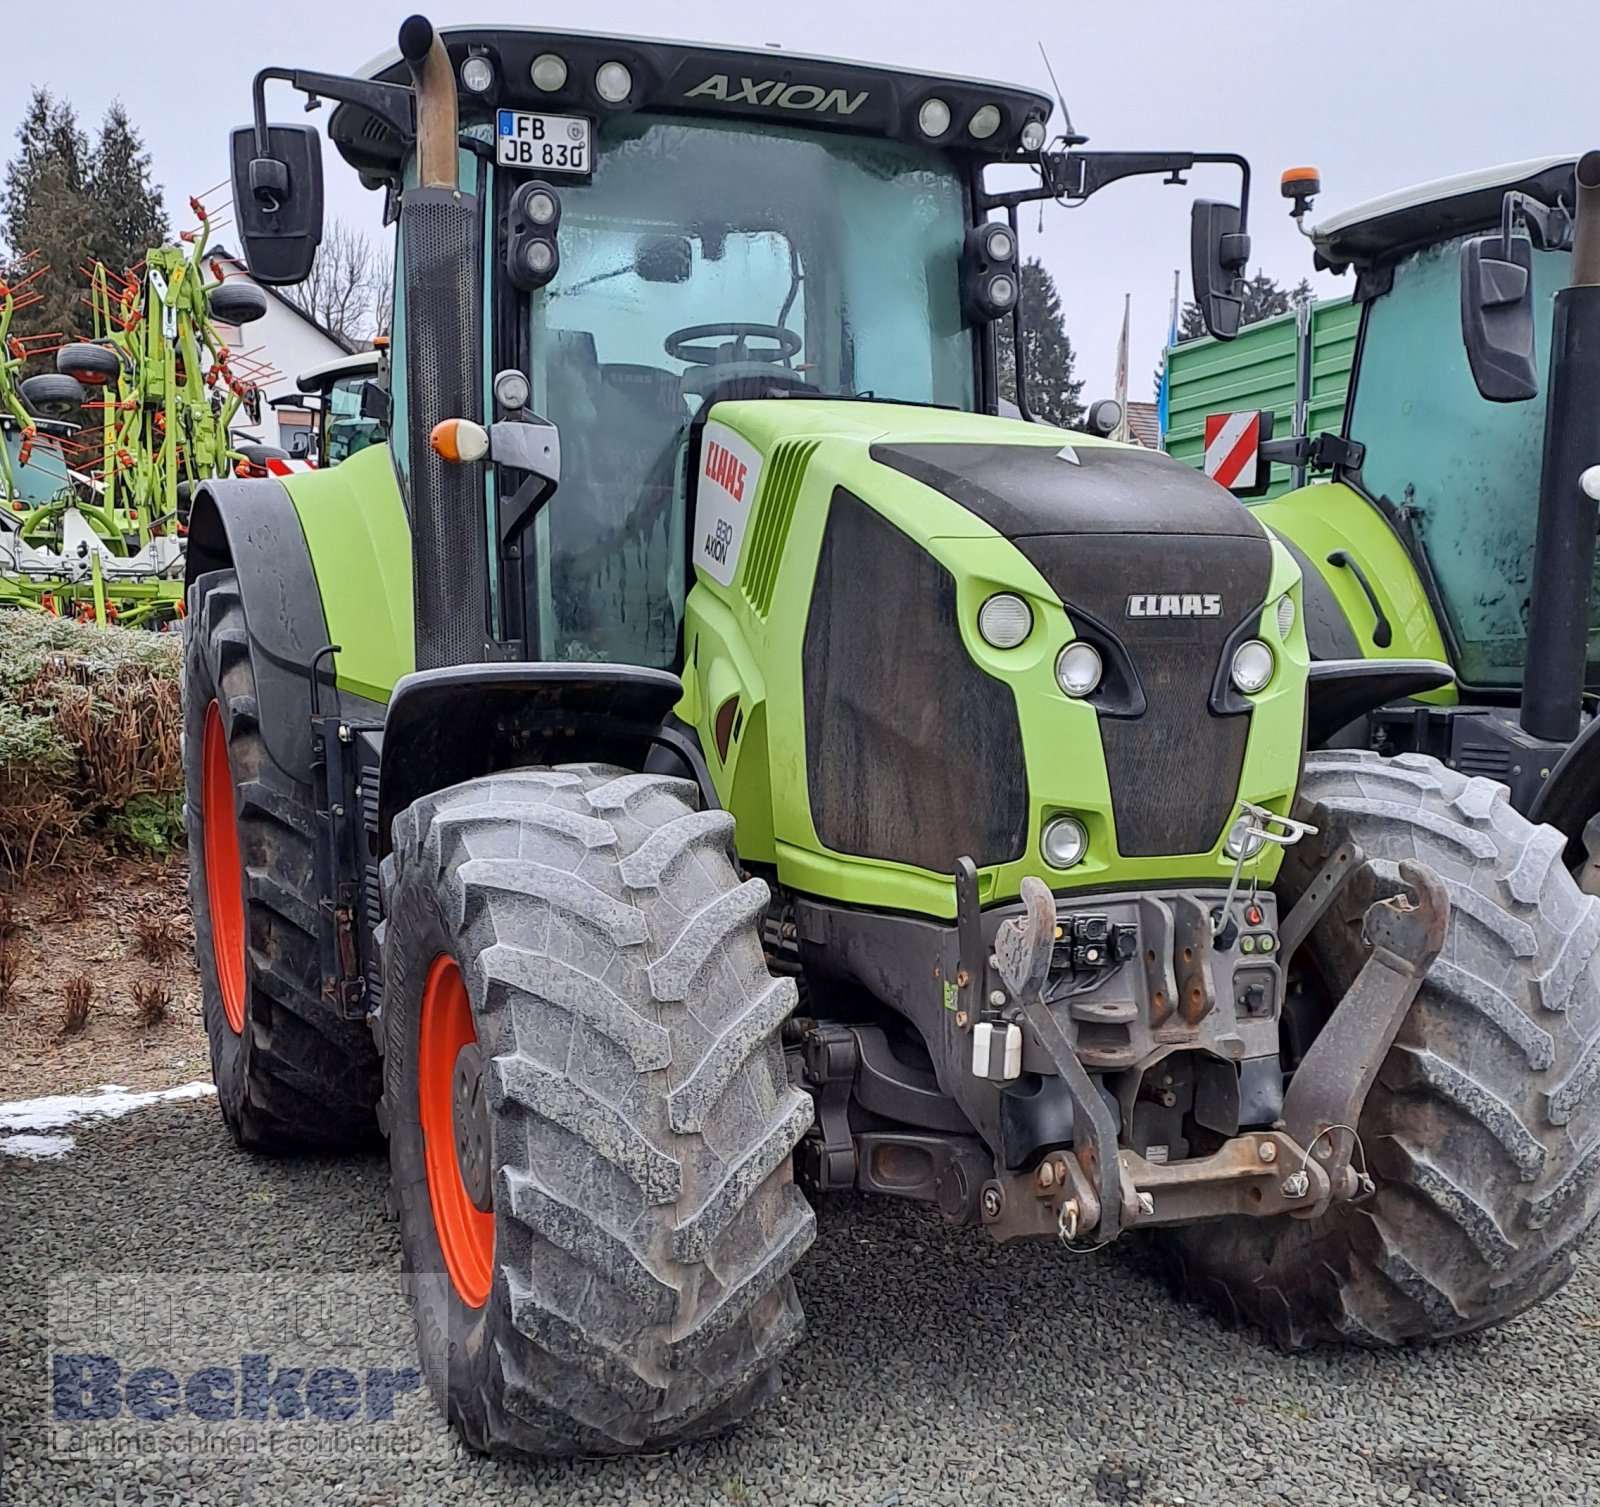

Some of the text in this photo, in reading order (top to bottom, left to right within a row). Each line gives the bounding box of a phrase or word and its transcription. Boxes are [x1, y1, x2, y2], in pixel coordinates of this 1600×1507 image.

[684, 74, 869, 115] AXION
[517, 116, 545, 140] FB
[505, 140, 583, 168] JB 830
[705, 440, 748, 503] CLAAS
[715, 518, 733, 546] 830
[704, 534, 728, 566] AXION
[1129, 595, 1221, 616] CLAAS
